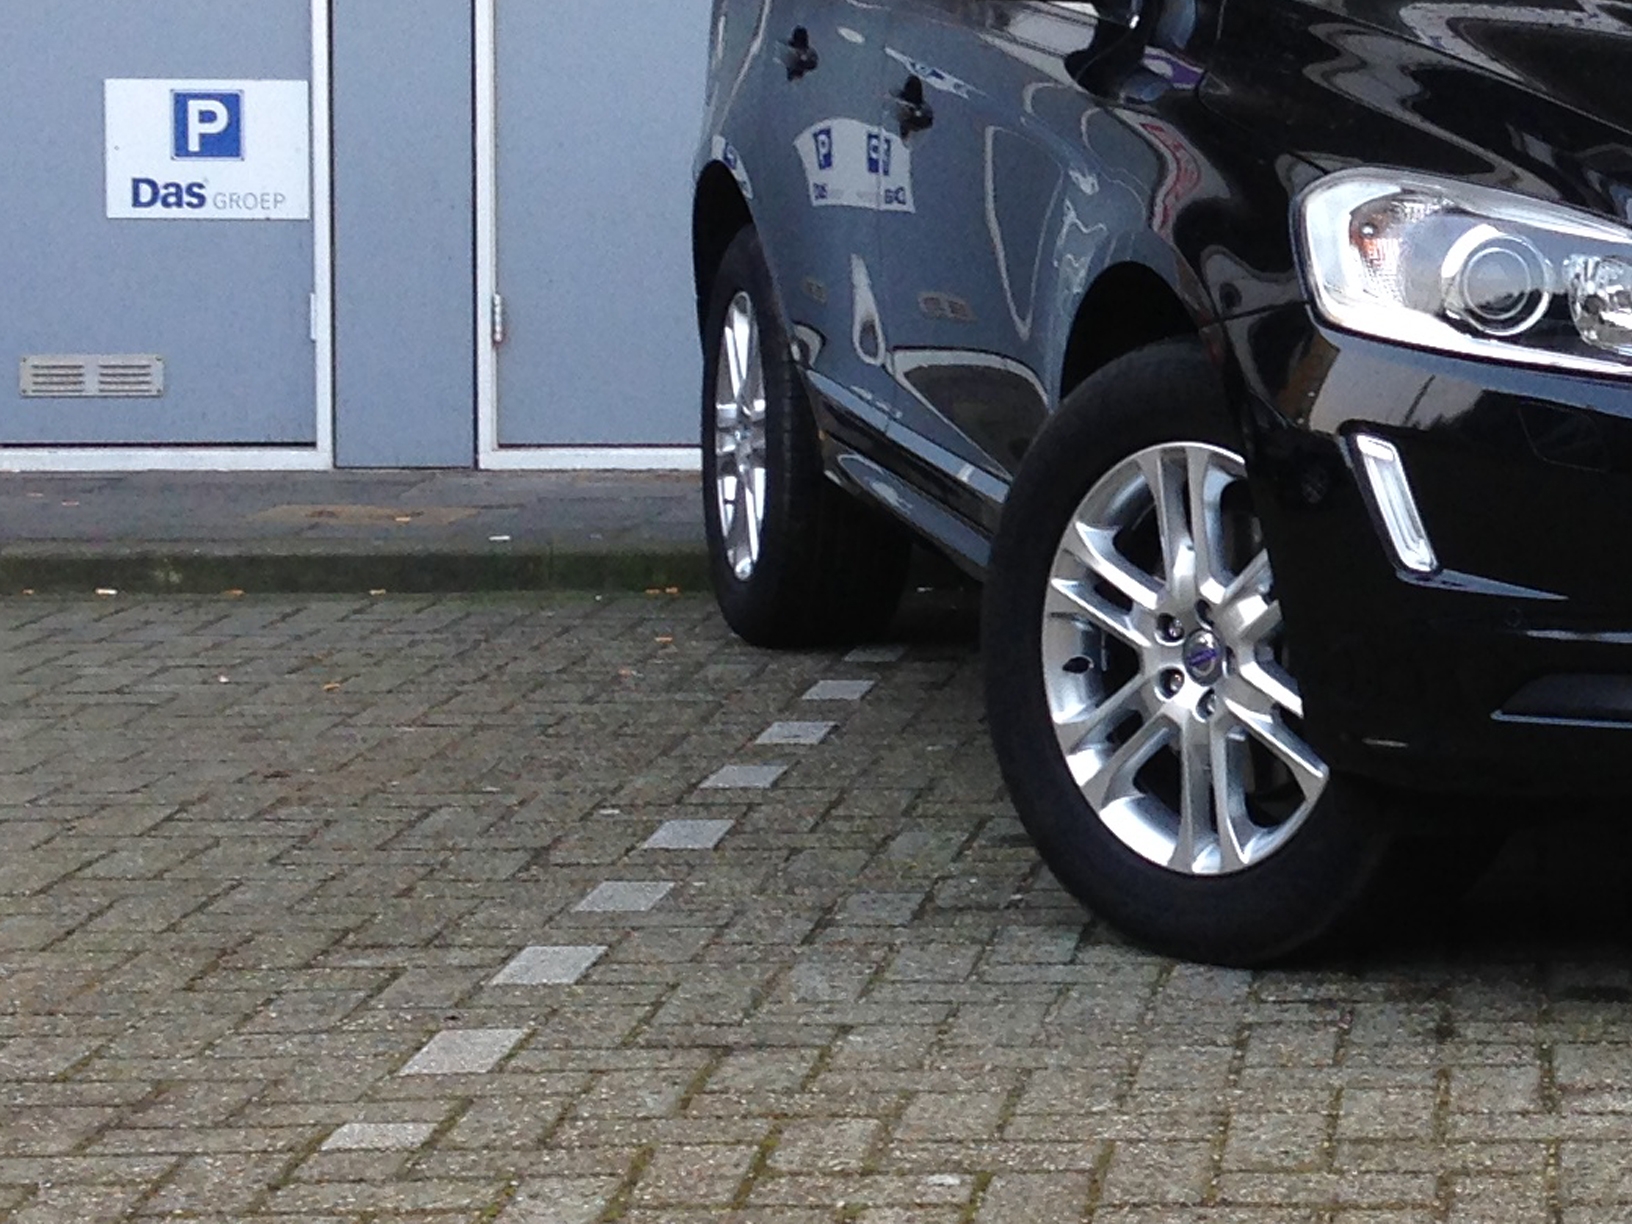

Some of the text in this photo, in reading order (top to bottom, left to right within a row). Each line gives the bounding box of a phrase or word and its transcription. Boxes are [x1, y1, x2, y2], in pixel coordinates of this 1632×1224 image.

[187, 99, 229, 152] P
[131, 177, 287, 211] Das GROEP
